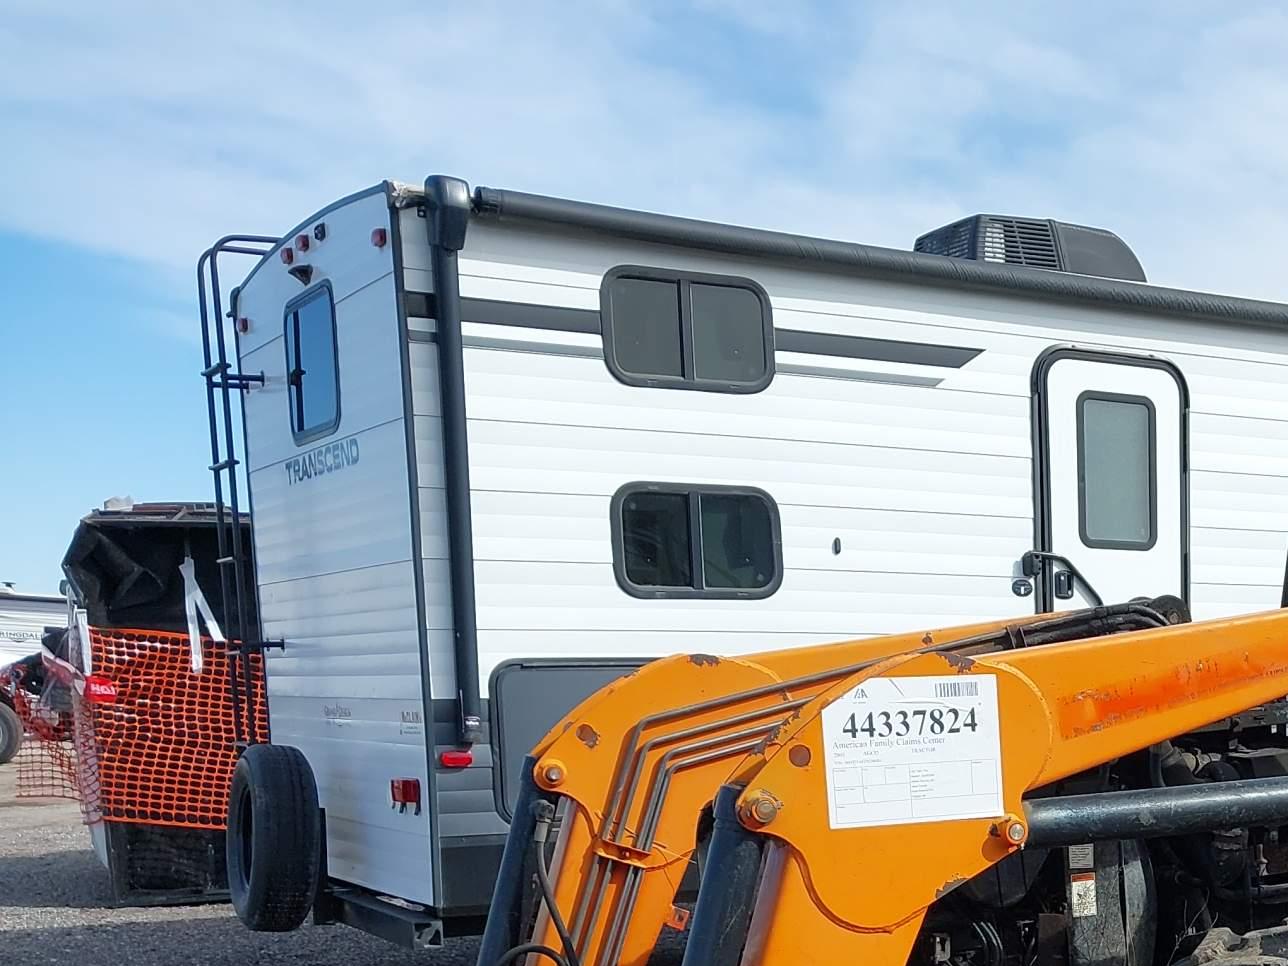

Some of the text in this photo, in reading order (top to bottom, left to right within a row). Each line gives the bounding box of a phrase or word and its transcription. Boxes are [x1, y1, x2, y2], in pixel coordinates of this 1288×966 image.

[285, 438, 360, 486] TRANSCEND
[842, 707, 978, 739] 44337824
[869, 739, 895, 748] Family
[896, 737, 921, 746] Claims
[922, 736, 946, 745] Center
